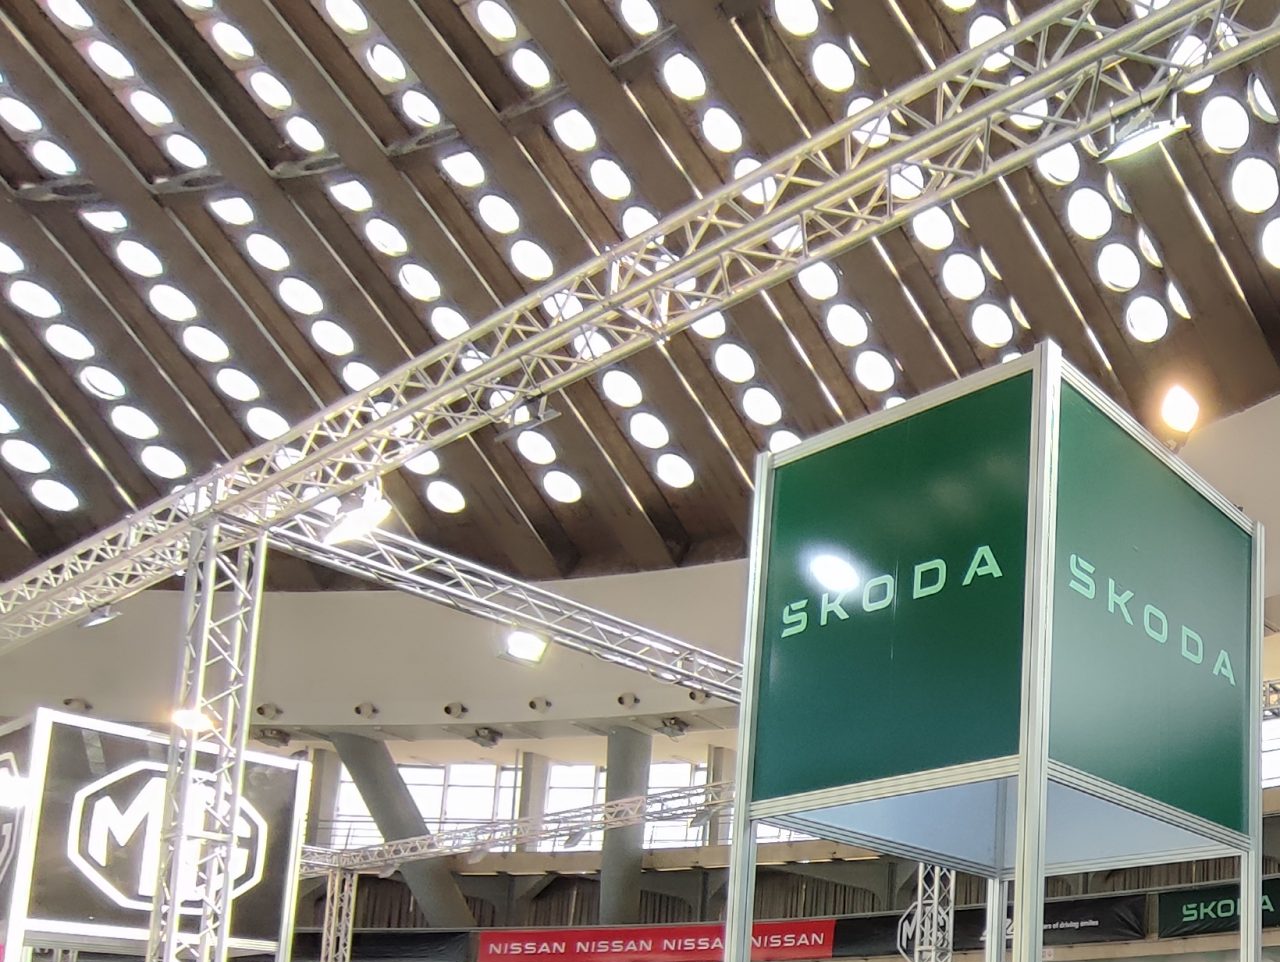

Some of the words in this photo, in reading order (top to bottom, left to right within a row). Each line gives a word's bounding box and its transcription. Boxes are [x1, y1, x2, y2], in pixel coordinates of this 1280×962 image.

[1182, 894, 1275, 922] SKOA
[489, 941, 566, 955] NISSAN
[575, 939, 653, 953] NISSAN
[663, 937, 724, 951] NISSA
